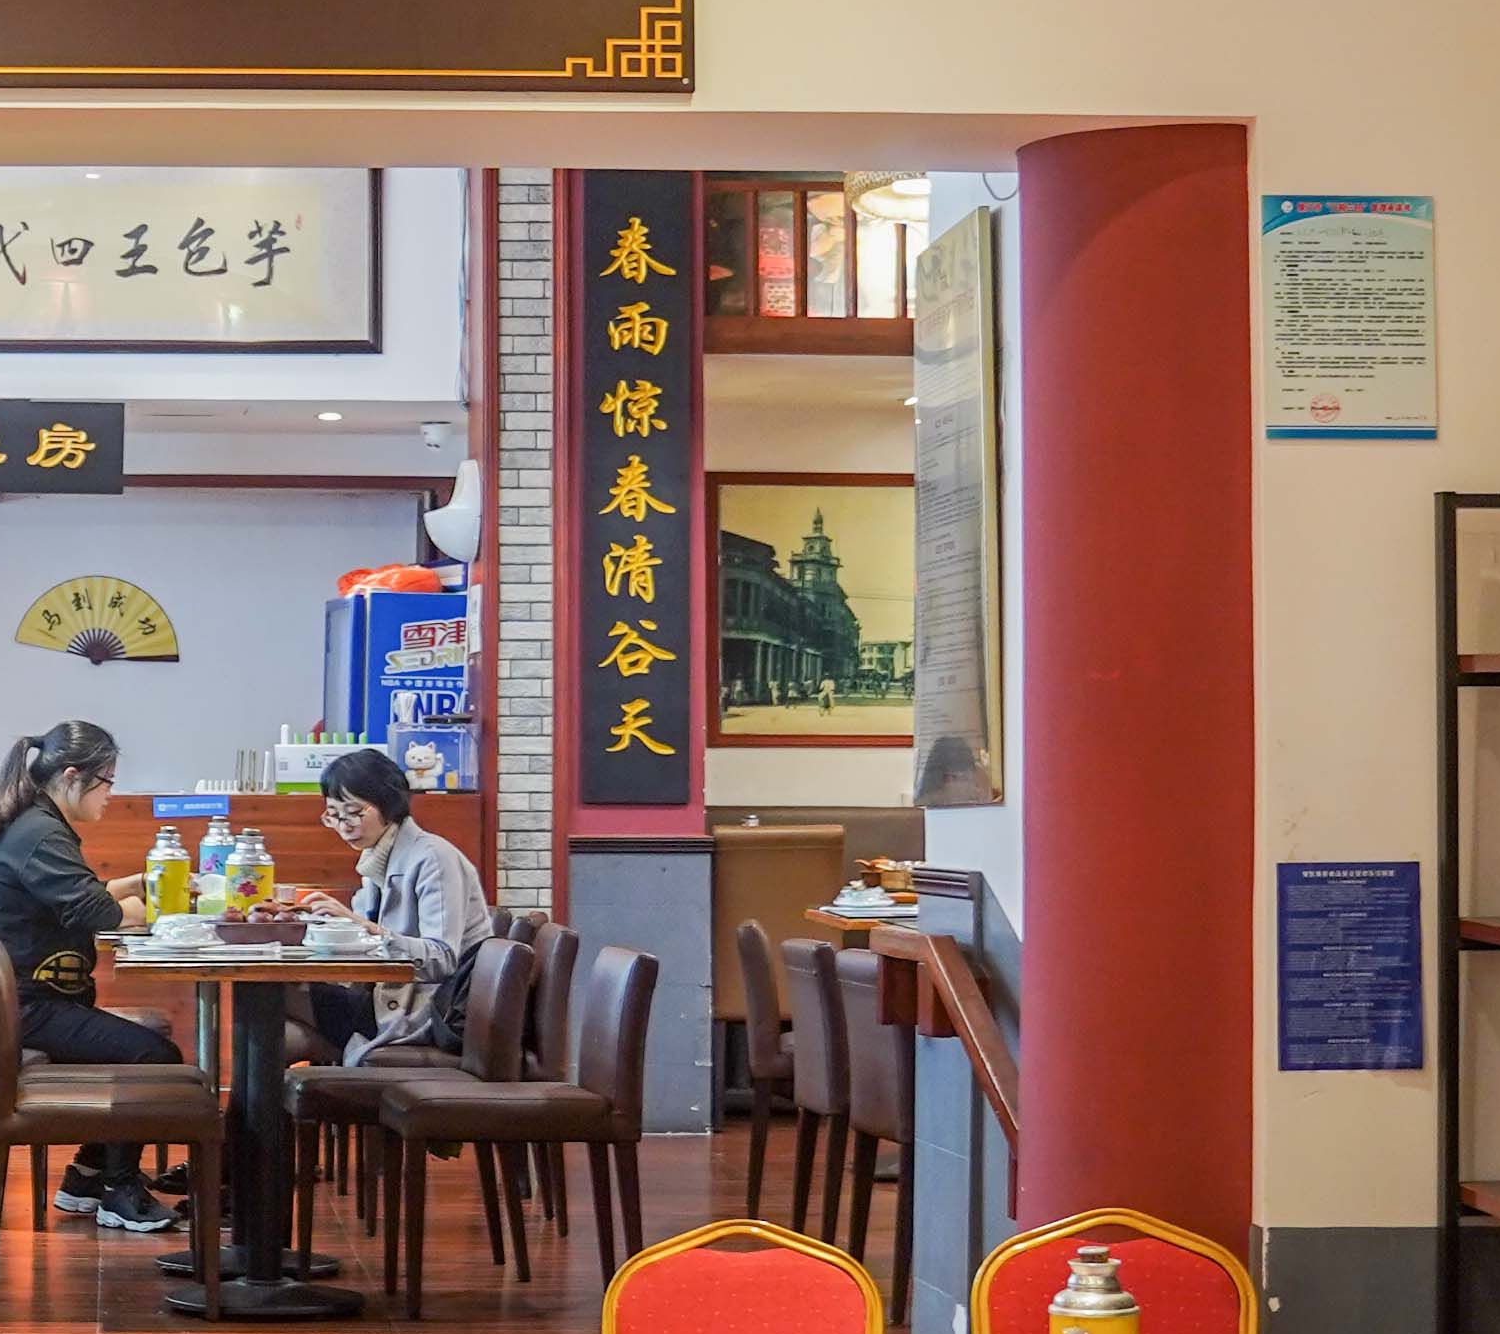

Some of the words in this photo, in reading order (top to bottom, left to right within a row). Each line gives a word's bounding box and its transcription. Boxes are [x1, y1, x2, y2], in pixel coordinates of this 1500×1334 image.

[41, 587, 157, 636] 马到成功
[599, 216, 676, 756] 春雨惊春清谷天
